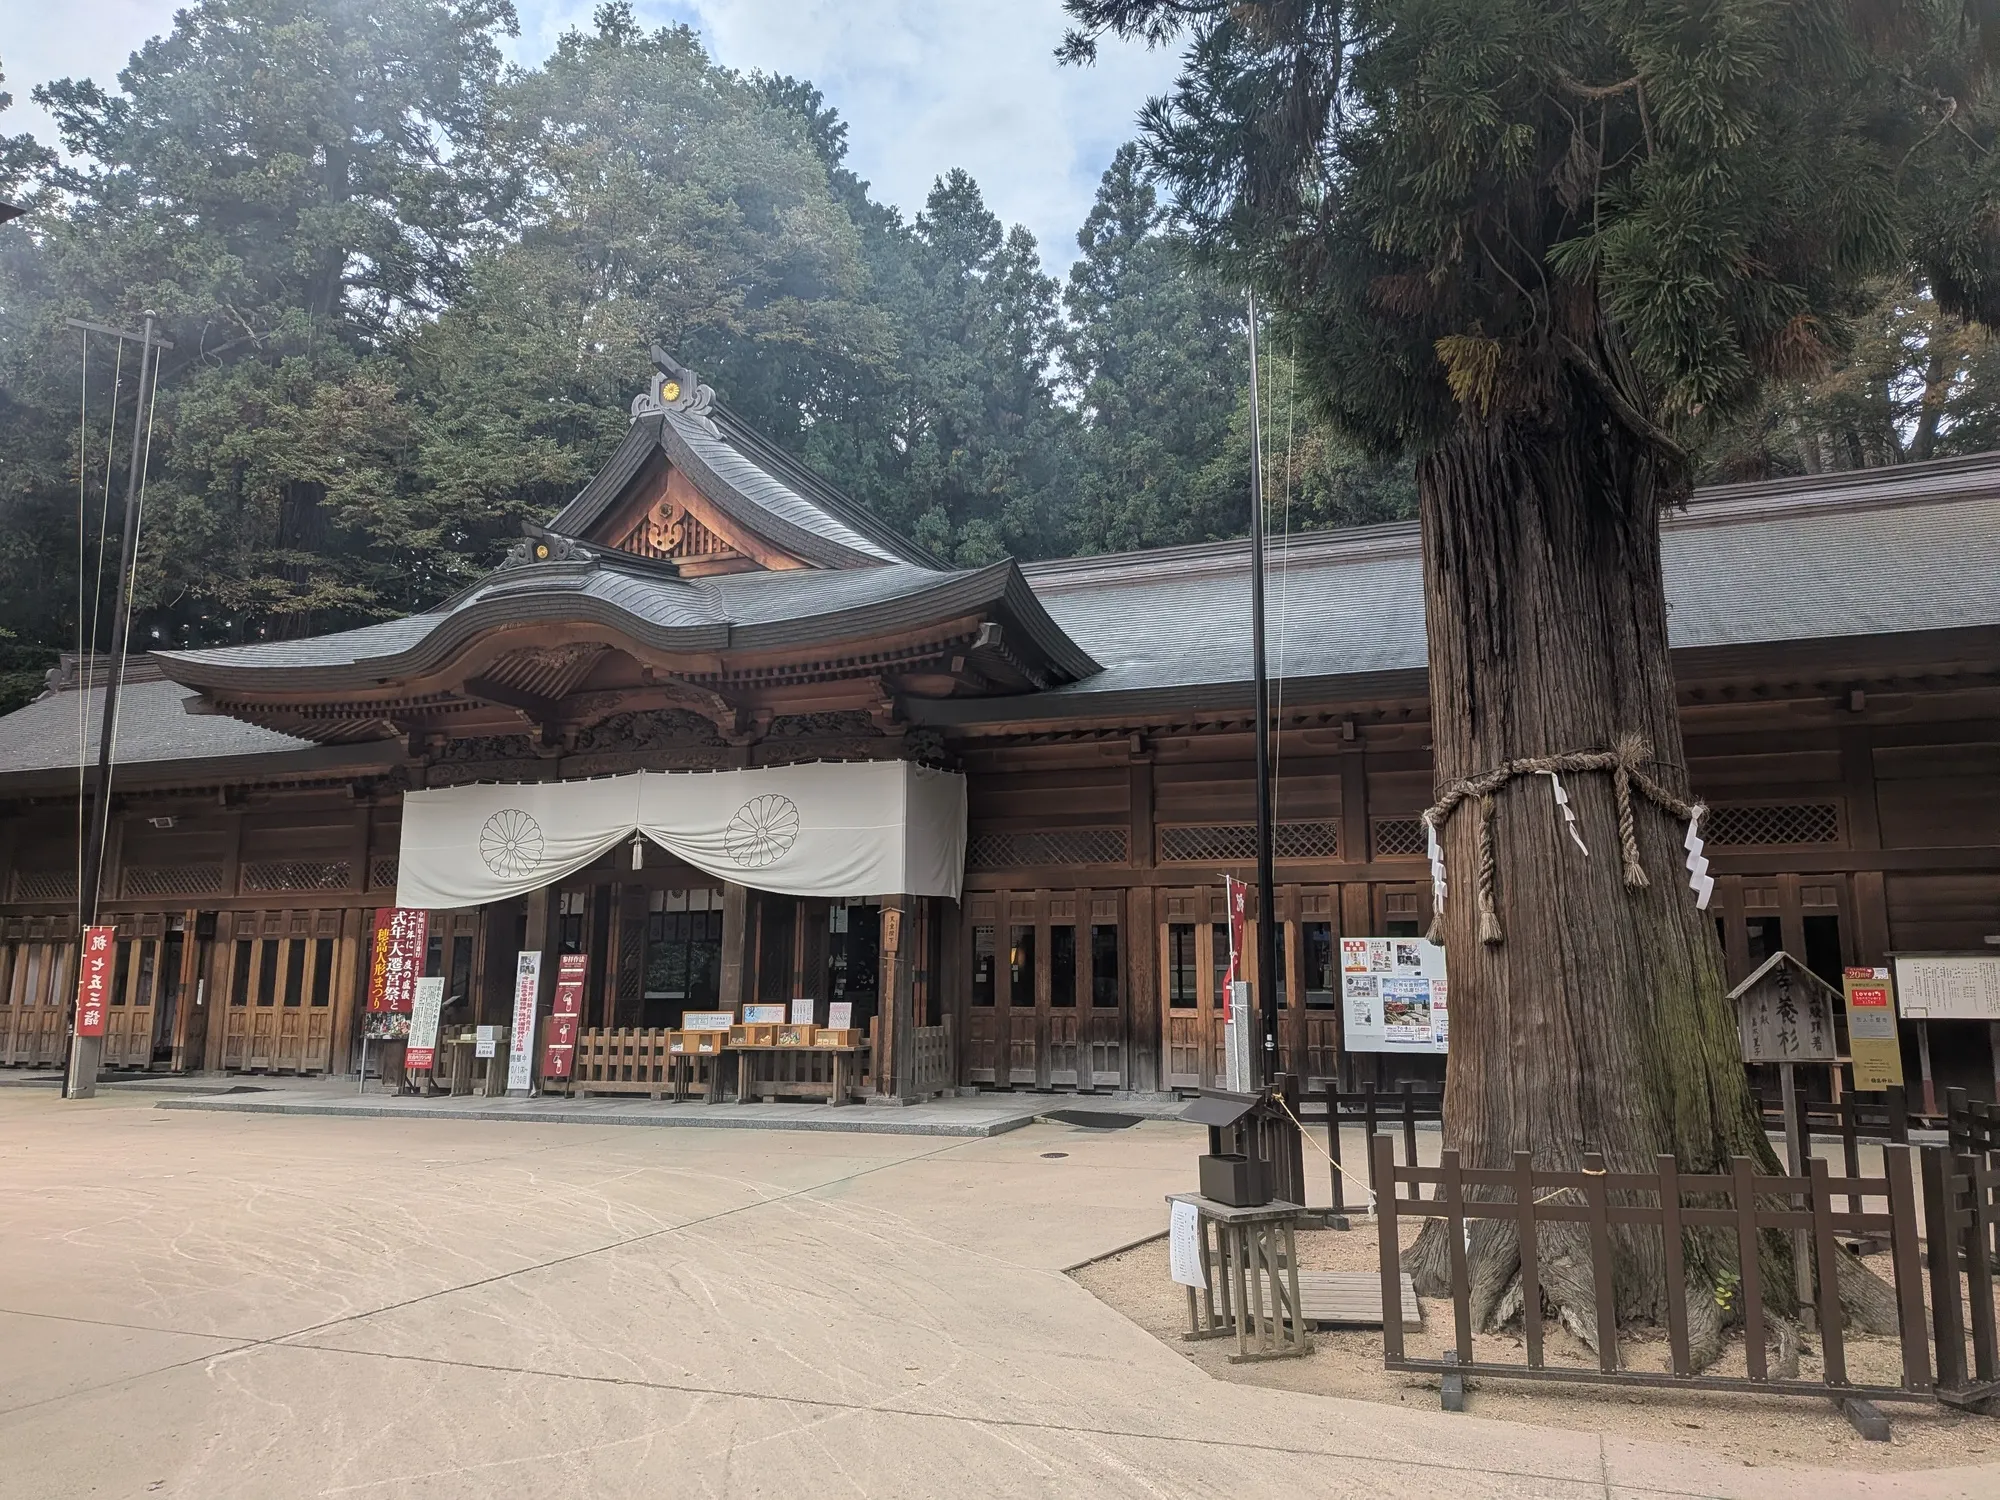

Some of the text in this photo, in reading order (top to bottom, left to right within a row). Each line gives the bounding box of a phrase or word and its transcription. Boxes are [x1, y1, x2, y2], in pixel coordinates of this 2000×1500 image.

[372, 928, 390, 1009] 穂高人形まつり
[383, 911, 407, 1010] 式年大遷宮祭と
